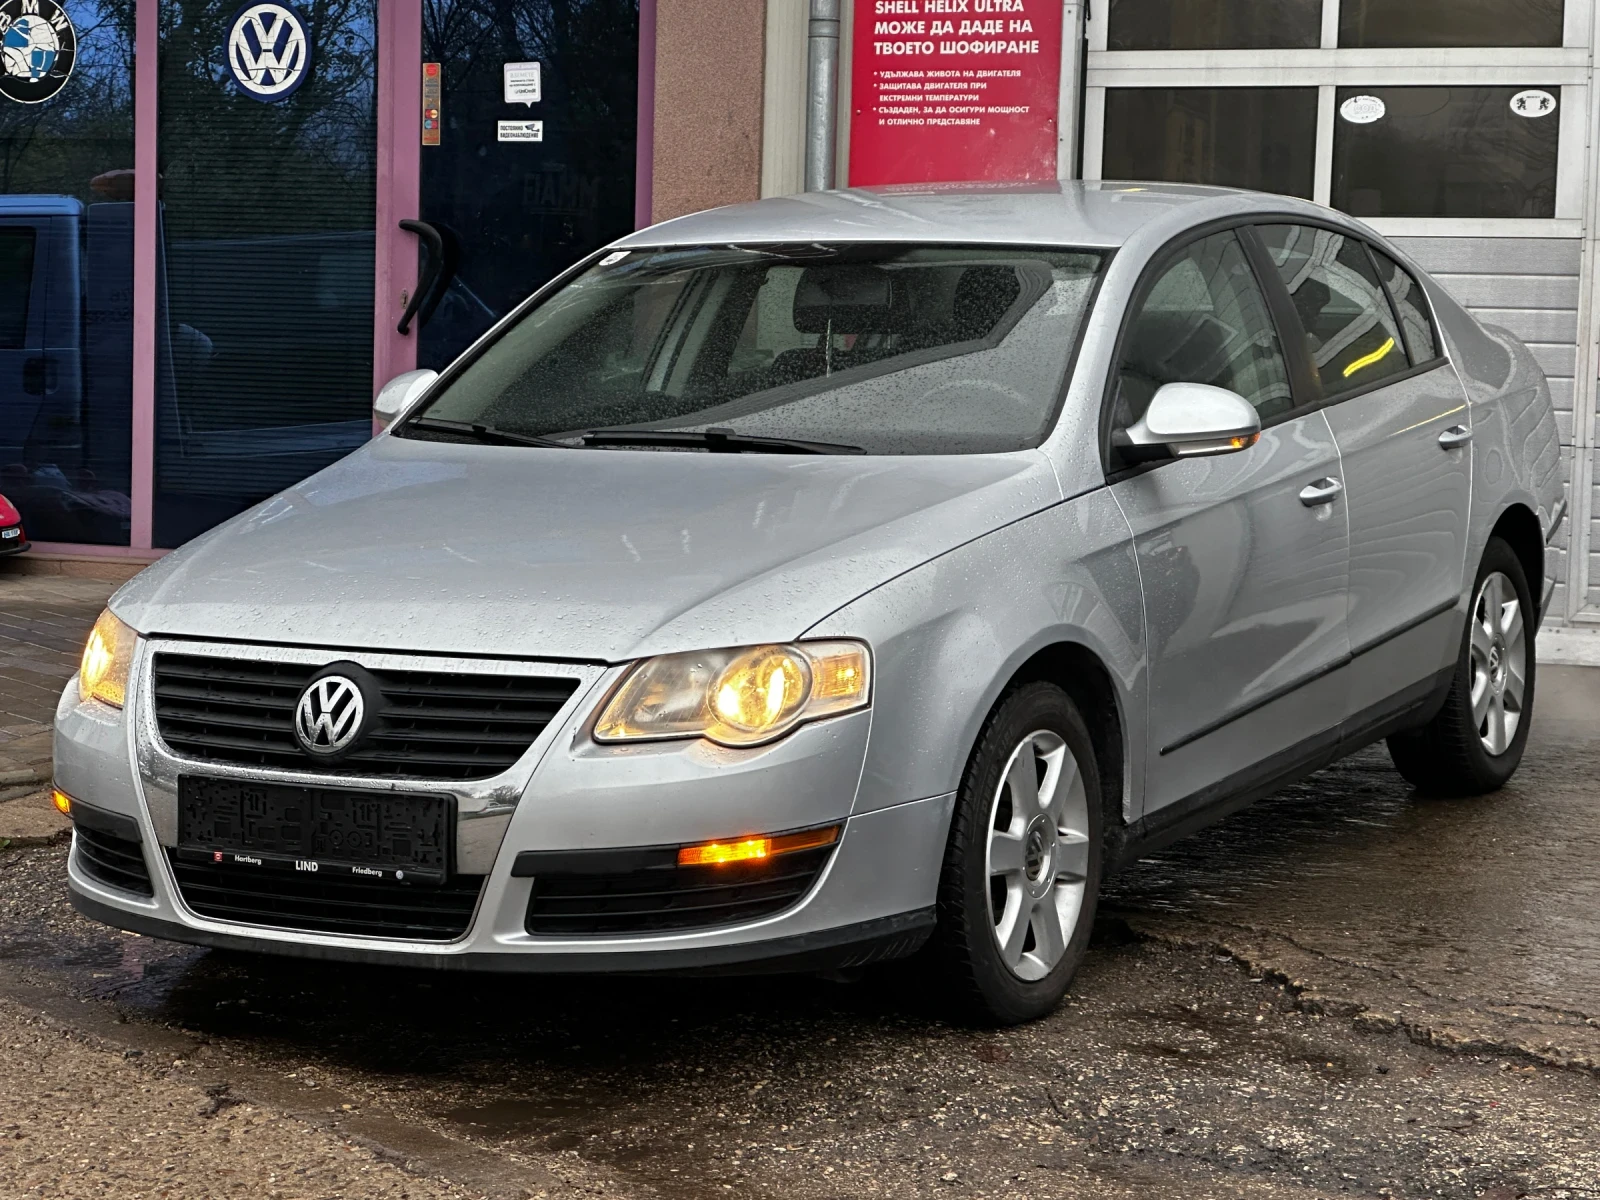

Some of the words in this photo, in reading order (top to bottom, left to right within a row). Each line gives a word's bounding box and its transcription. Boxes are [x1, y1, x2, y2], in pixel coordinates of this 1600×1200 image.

[875, 0, 919, 14] SHELL
[924, 0, 969, 13] HELIX
[974, 0, 1024, 12] ULTRA
[874, 21, 925, 35] МОЖЕ
[930, 20, 954, 36] ДА
[958, 20, 1004, 36] ДАДЕ
[1009, 19, 1033, 33] НА
[874, 41, 935, 55] ТВОЕТО
[939, 40, 1039, 54] ШОФИРАНЕ
[880, 70, 924, 78] УДЪЛЖАВА
[976, 70, 1021, 78] ДВИГАТЕЛЯ
[924, 82, 968, 90] ДВИГАТЕЛЯ
[878, 106, 921, 114] СЪЗДАДЕН,
[935, 106, 947, 114] ДА
[987, 105, 1030, 114] МОЩНОСТ
[927, 118, 980, 126] ПРЕДСТАВЯНЕ
[234, 854, 262, 866] Hartberg
[295, 860, 319, 872] LIND
[352, 866, 383, 878] Friedberg
